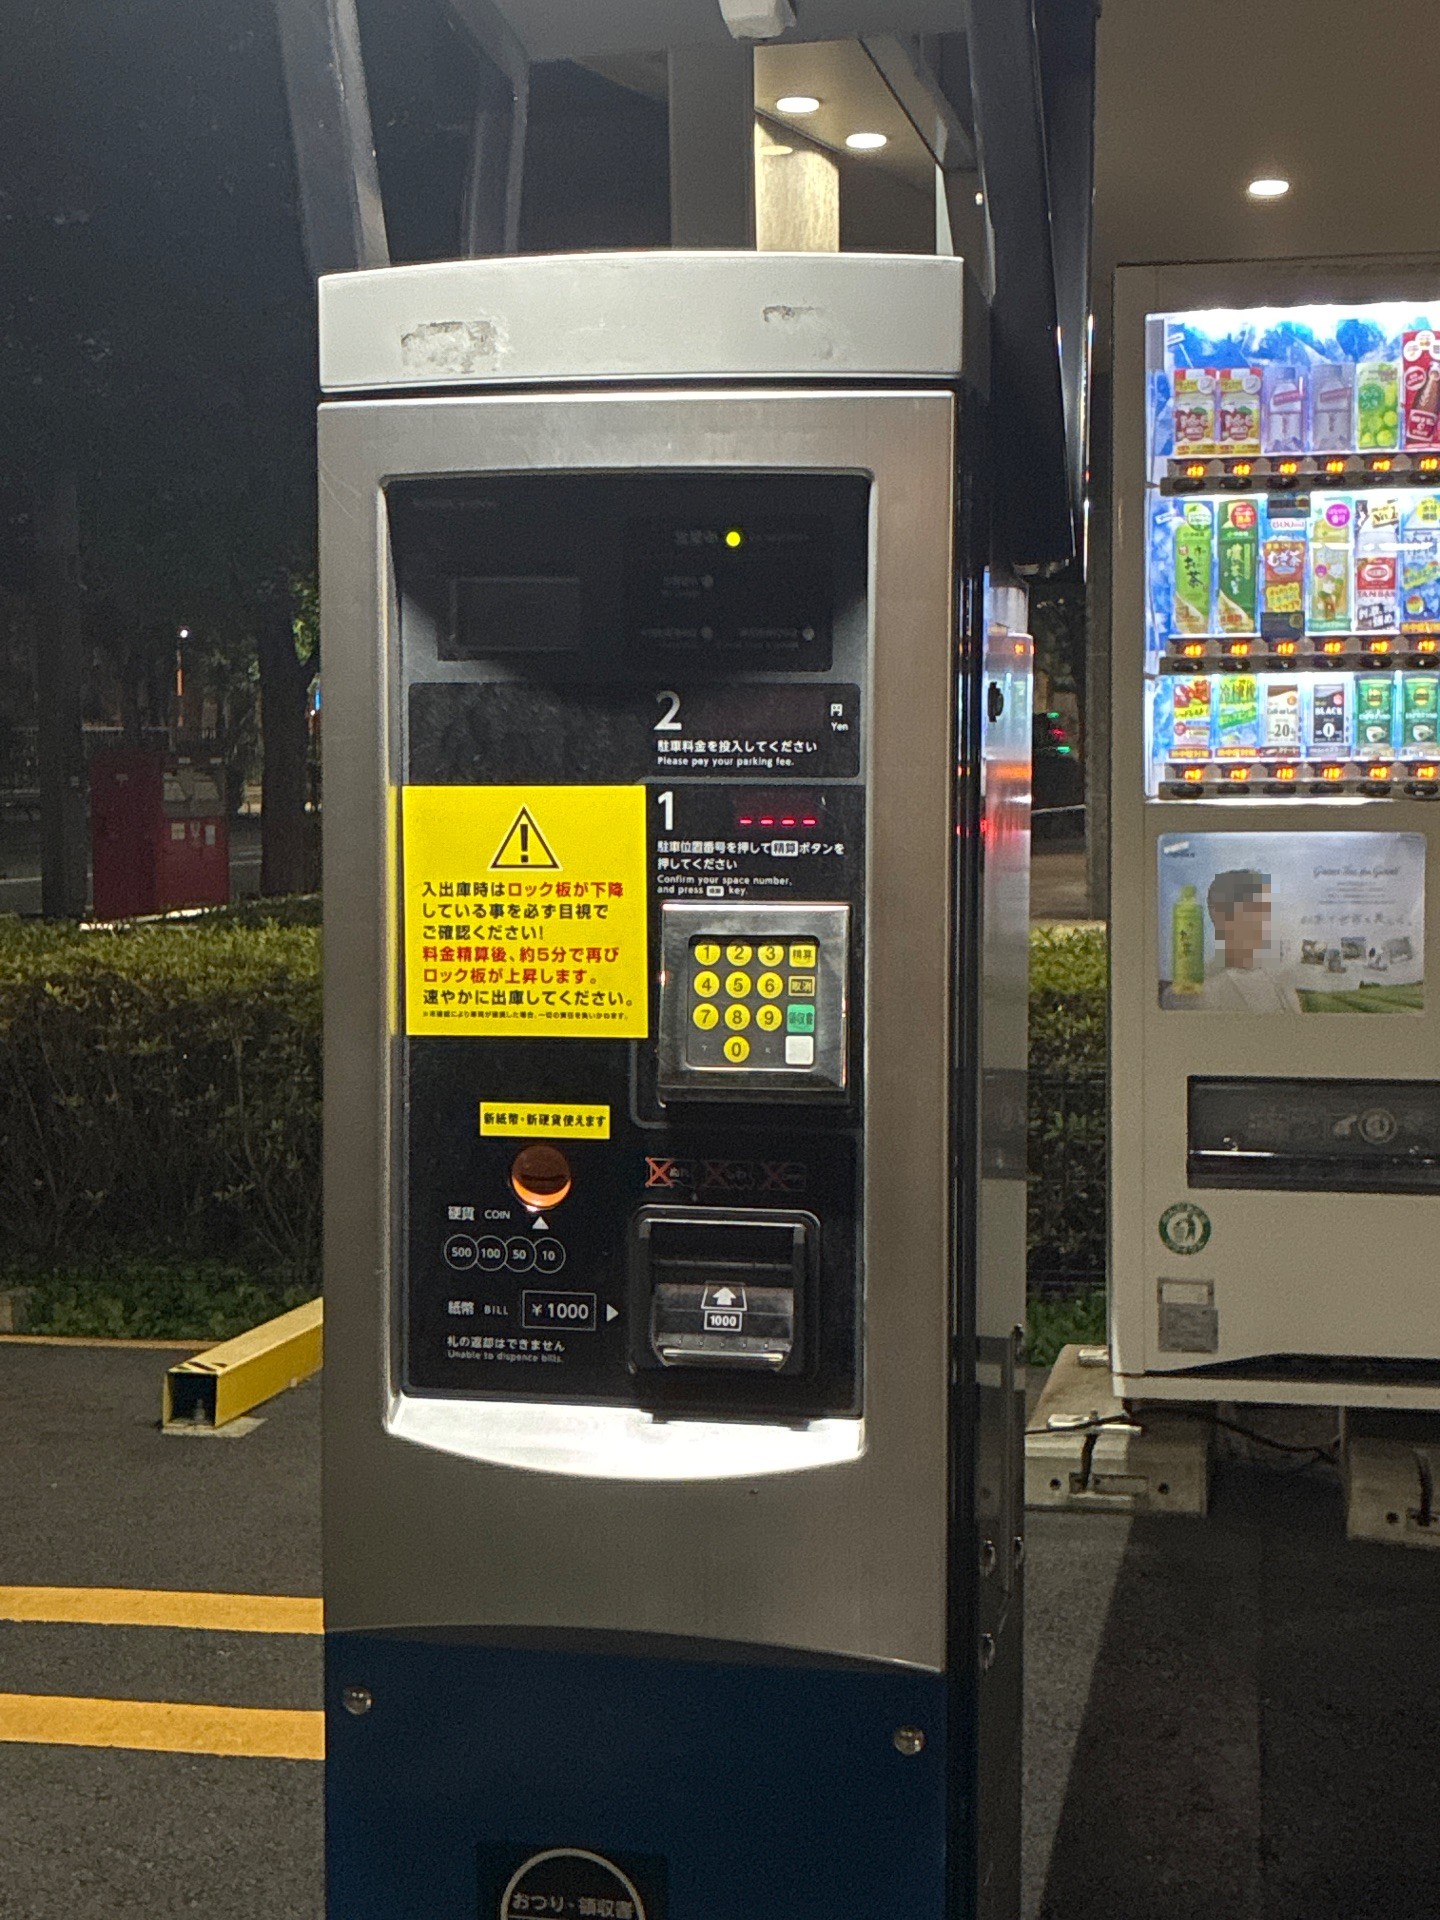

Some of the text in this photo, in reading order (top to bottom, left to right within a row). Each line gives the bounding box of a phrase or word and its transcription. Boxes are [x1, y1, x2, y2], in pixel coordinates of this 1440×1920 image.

[654, 691, 682, 730] 2
[830, 704, 843, 717] 円
[1315, 707, 1342, 715] BLACK
[831, 722, 849, 731] Yen
[1274, 724, 1290, 737] 20
[657, 740, 818, 753] 駐車料金を投入してください
[657, 757, 795, 768] Please pay your parking fee.
[657, 791, 674, 830] 1
[657, 858, 738, 870] 押してください
[657, 874, 695, 883] Confirm
[698, 876, 719, 885] your
[722, 876, 750, 886] space
[422, 881, 624, 898] 入出庫時はロック板が下降
[657, 885, 675, 894] and
[678, 886, 704, 896] press
[728, 886, 748, 896] key.
[422, 903, 609, 920] している事を必ず目視で
[422, 946, 619, 963] 料金精算後、約5分で再び
[703, 947, 709, 960] 1
[735, 947, 744, 960] 2
[766, 947, 775, 960] 3
[424, 968, 597, 984] ロック板が上昇します。
[702, 978, 712, 991] 4
[733, 978, 744, 992] 5
[765, 979, 774, 992] 6
[423, 990, 633, 1007] 速やかに出庫してください。
[701, 1010, 711, 1023] 7
[732, 1010, 742, 1024] 8
[764, 1011, 774, 1025] 9
[731, 1043, 741, 1057] 0
[484, 1112, 607, 1128] 新紙幣・新硬貨使えます
[448, 1206, 511, 1221] 硬貨 COIN
[451, 1247, 555, 1261] 500 100 50 10
[448, 1301, 475, 1316] 紙幣
[484, 1305, 508, 1316] BILL
[710, 1314, 737, 1327] 1000
[447, 1335, 566, 1353] 札の返却はできません
[448, 1350, 481, 1360] Unable
[484, 1351, 494, 1360] to
[512, 1892, 634, 1919] おつり・領収書
